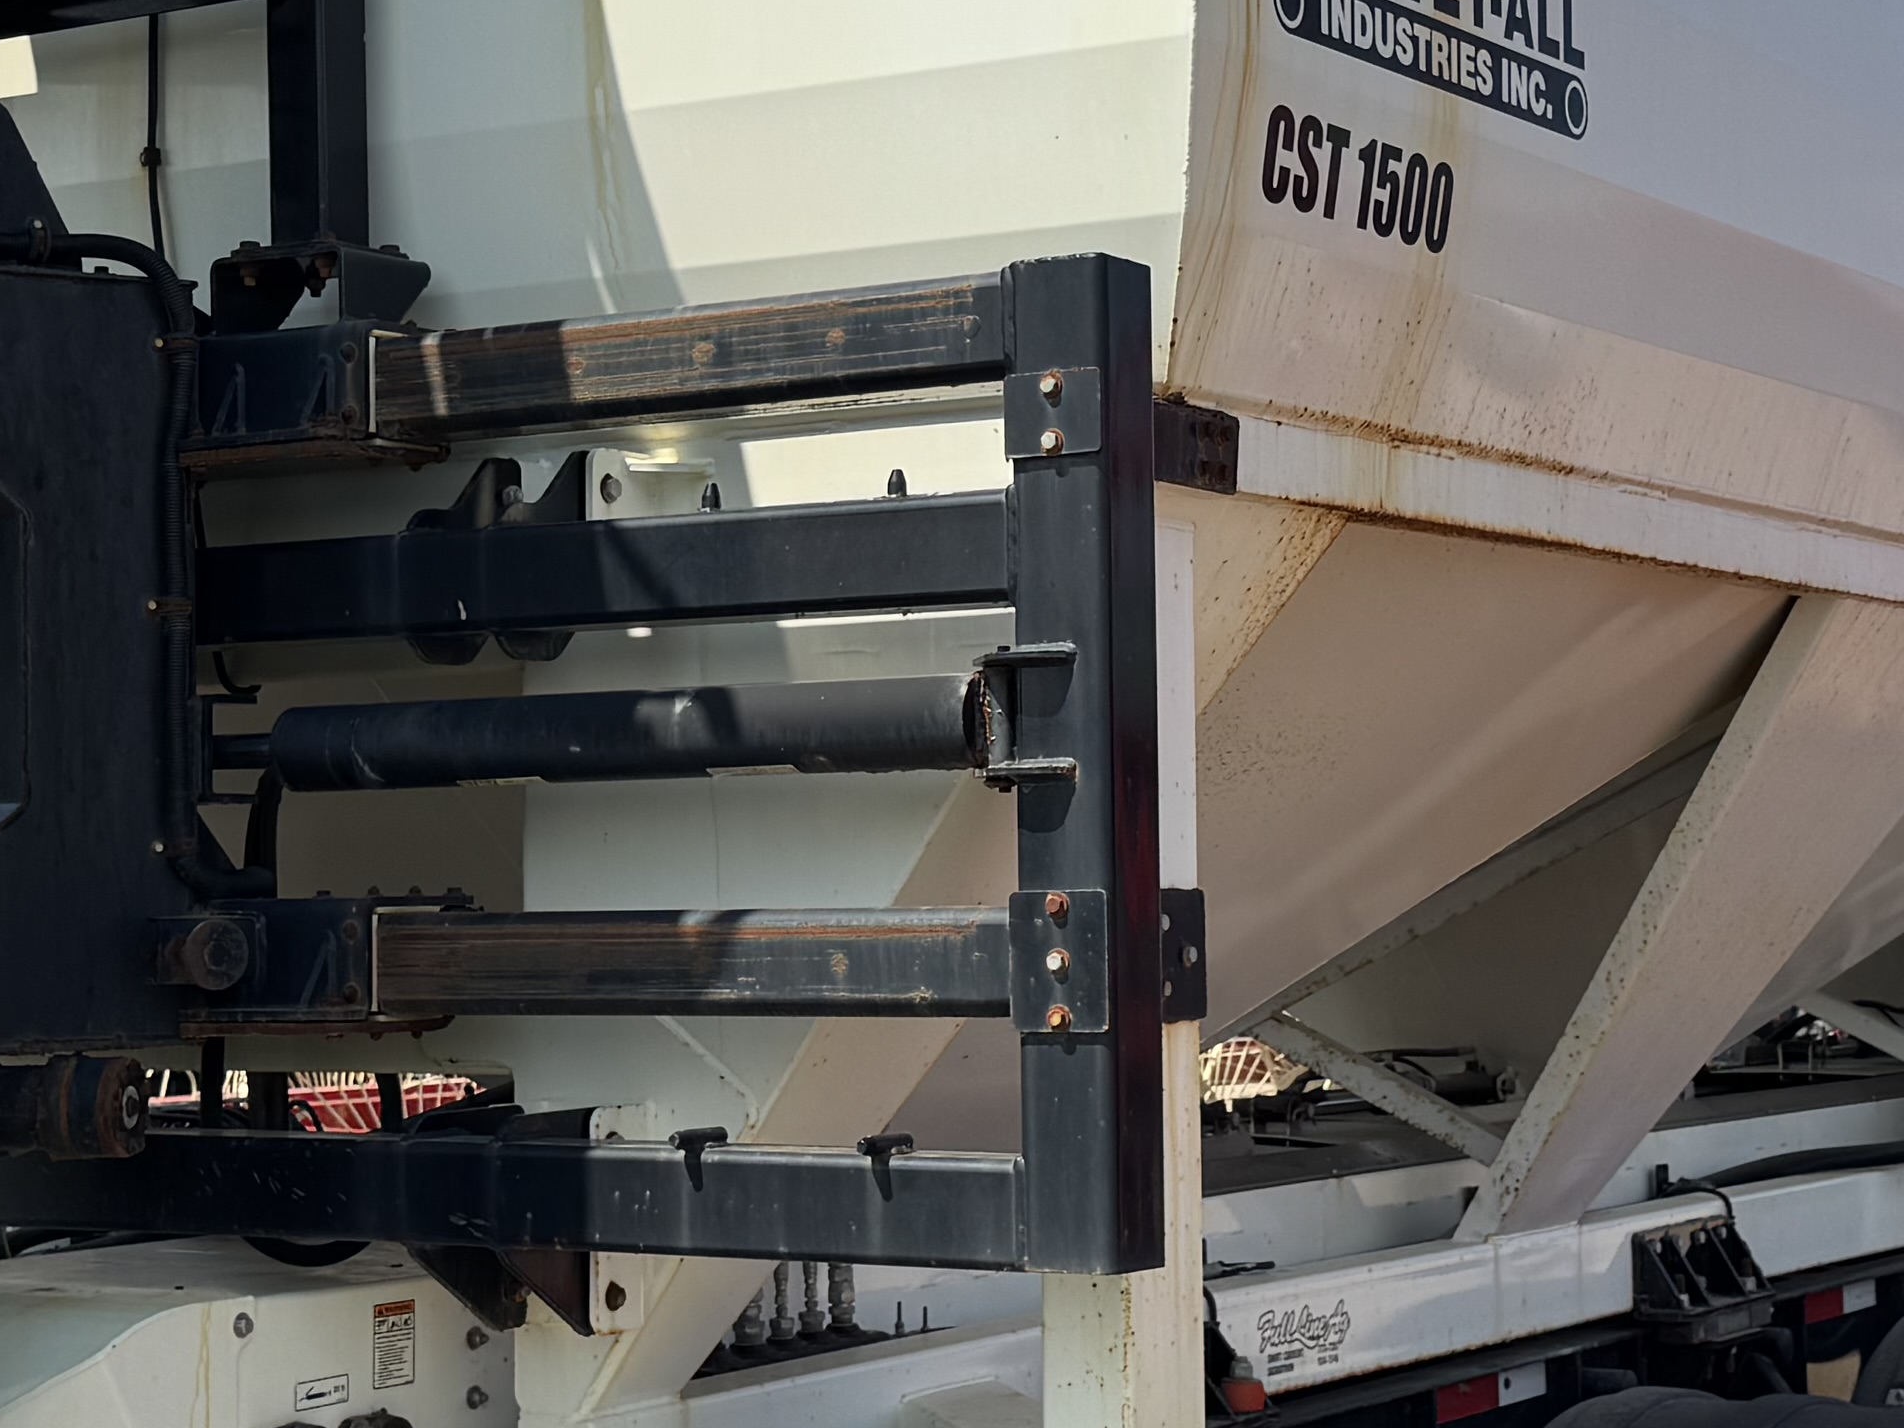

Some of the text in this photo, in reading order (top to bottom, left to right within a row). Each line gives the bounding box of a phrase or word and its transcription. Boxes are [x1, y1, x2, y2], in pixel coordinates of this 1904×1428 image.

[1501, 57, 1554, 121] INC.
[1260, 103, 1455, 254] CST 1500
